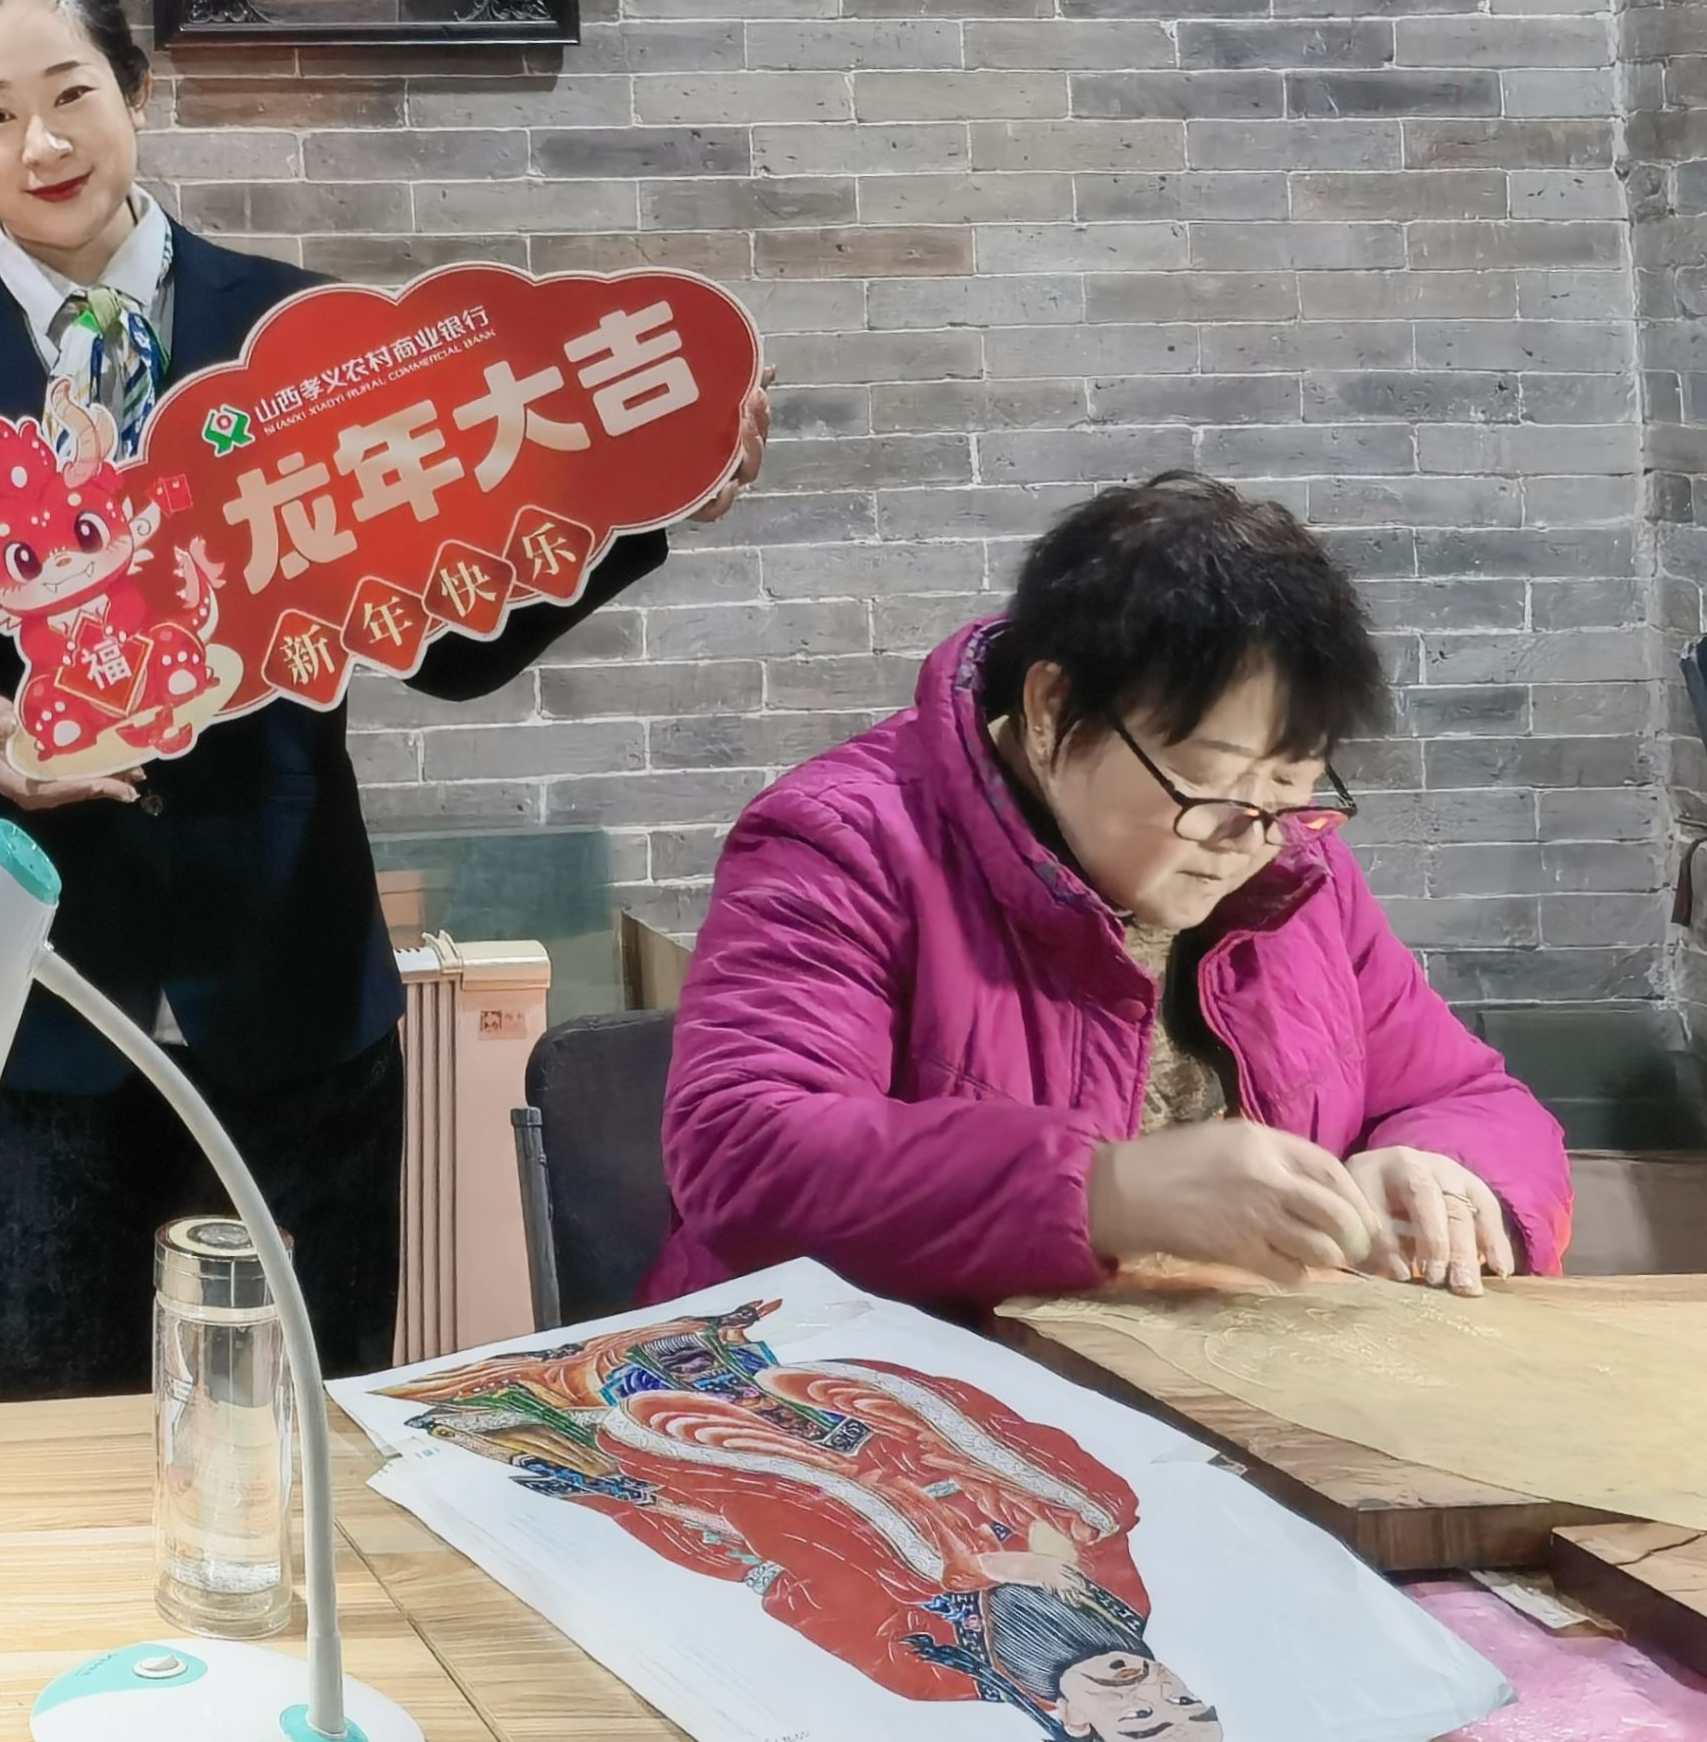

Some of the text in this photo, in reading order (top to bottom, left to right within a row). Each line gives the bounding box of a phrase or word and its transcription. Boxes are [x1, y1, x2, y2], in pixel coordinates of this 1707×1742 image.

[253, 305, 490, 423] 山西孝义农村商业银行
[264, 328, 497, 436] SHANXI XIAOYI RURAL COMMERCIAL BANK
[222, 300, 699, 596] 龙年大吉
[283, 522, 577, 686] 新年快乐
[80, 638, 132, 691] 福
